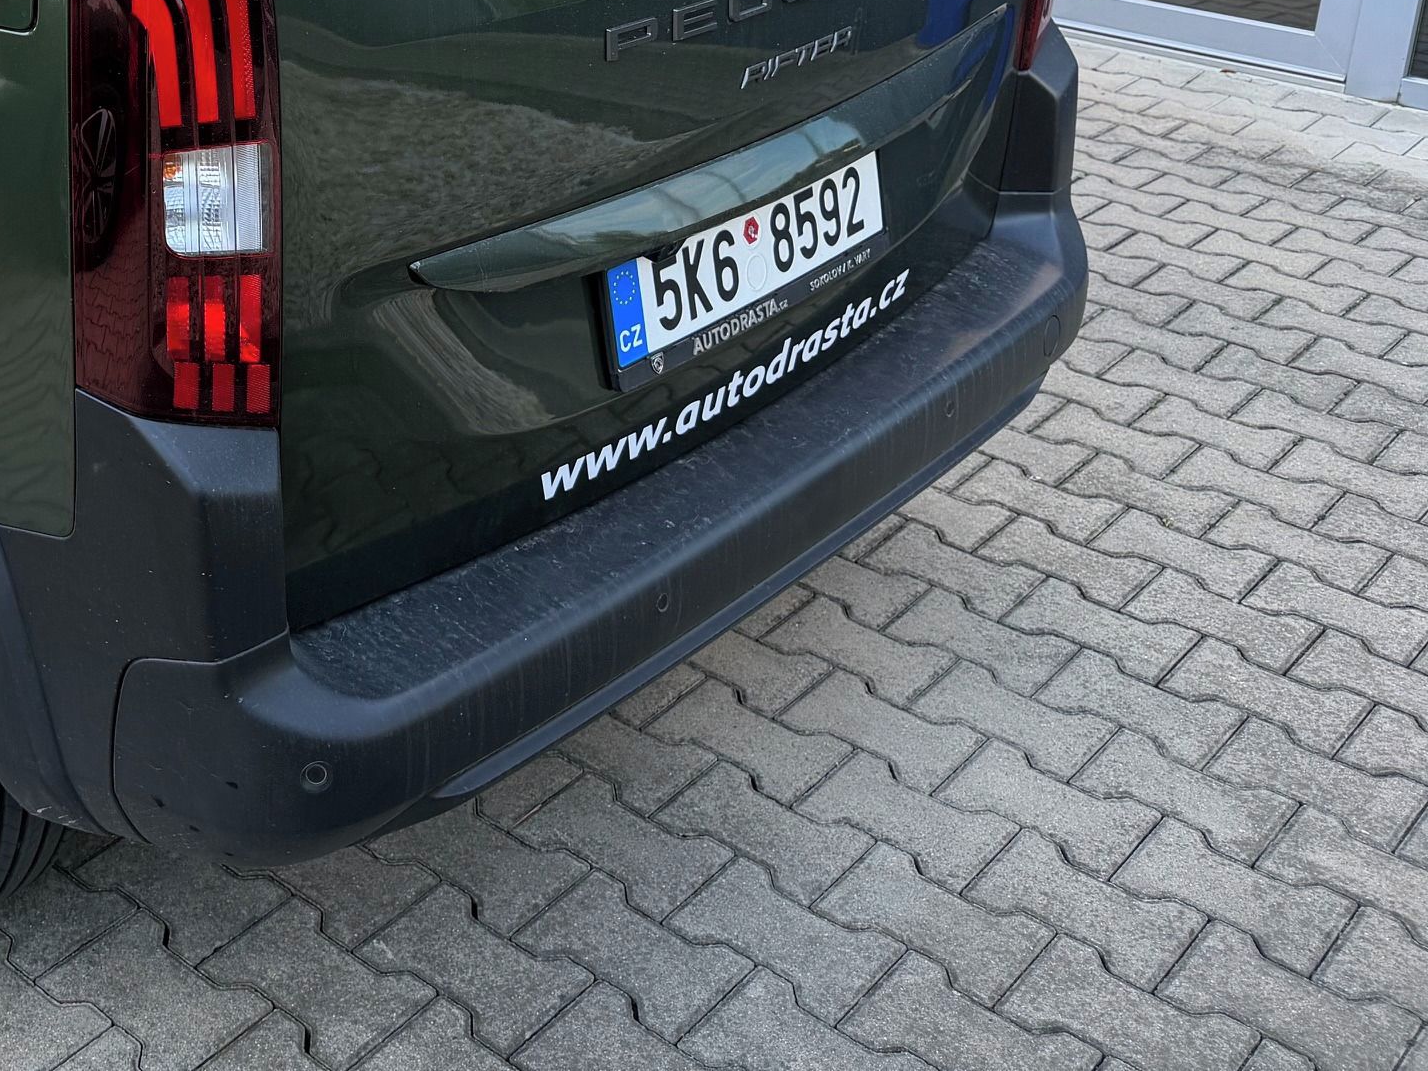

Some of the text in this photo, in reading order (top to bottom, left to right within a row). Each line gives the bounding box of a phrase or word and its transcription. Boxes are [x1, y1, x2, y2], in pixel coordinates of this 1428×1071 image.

[740, 25, 852, 90] RIFTER
[650, 165, 865, 331] 5K6 8592
[809, 265, 842, 291] SOKOLOV
[853, 248, 871, 266] VARY
[619, 323, 643, 353] CZ
[693, 298, 789, 356] AUTODRASTA.cz
[540, 267, 911, 501] www.autodrasta.cz
